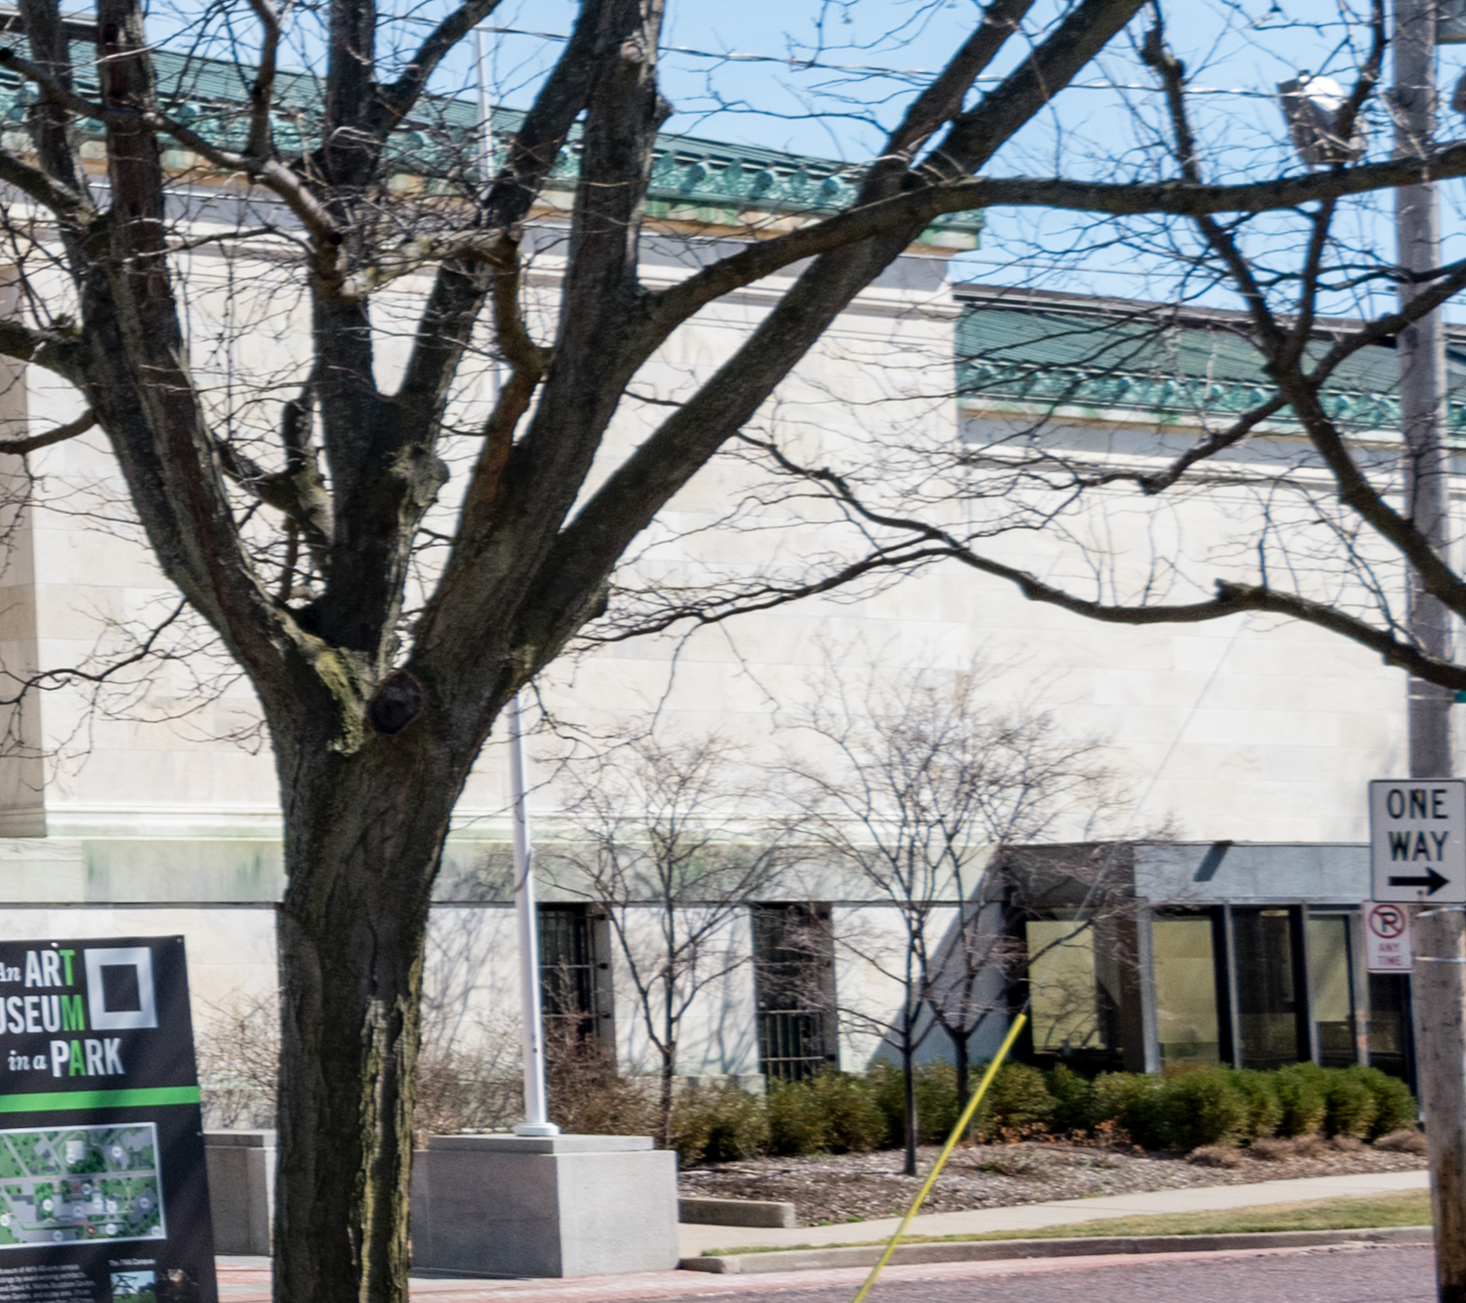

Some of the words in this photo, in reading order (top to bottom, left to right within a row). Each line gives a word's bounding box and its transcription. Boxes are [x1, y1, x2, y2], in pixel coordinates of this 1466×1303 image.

[1386, 788, 1449, 820] ONE
[1388, 830, 1449, 862] WAY
[24, 948, 76, 988] ART
[7, 1049, 30, 1071] in
[32, 1054, 47, 1070] a
[49, 1037, 125, 1078] PARK
